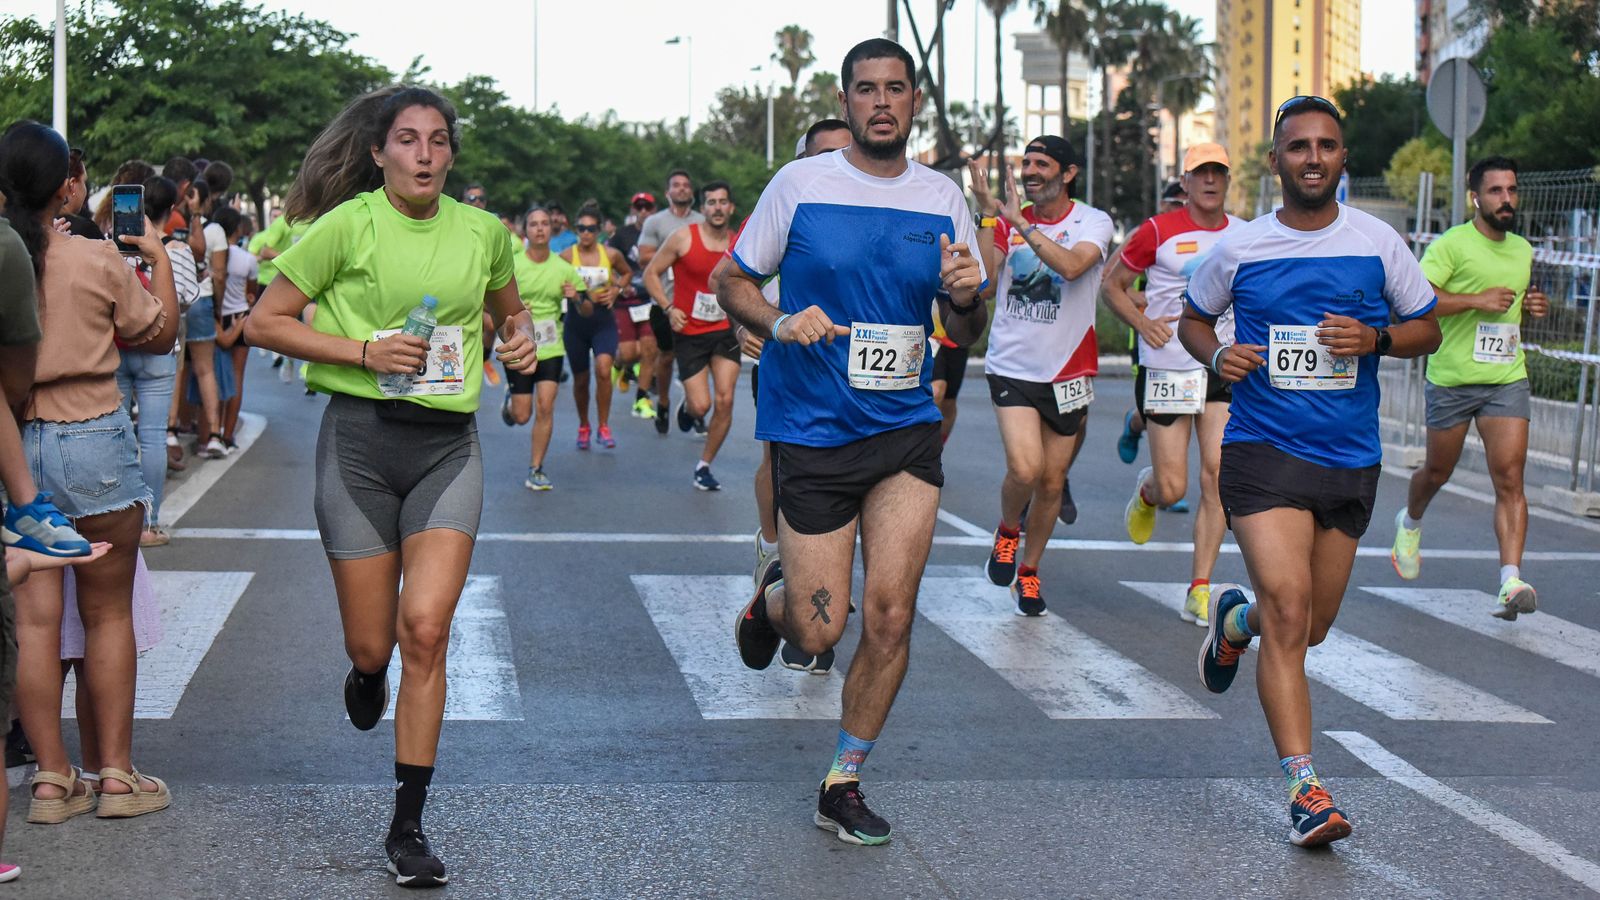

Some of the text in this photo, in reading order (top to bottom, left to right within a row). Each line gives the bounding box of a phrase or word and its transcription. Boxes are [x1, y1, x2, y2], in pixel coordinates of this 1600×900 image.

[903, 234, 928, 244] Algeciras
[1006, 295, 1057, 320] Vive la vida
[855, 328, 872, 339] XXI
[1274, 331, 1290, 341] XXI
[1480, 337, 1504, 352] 172
[857, 347, 897, 371] 122
[1277, 348, 1317, 372] 679
[1060, 380, 1082, 400] 752
[1152, 383, 1175, 397] 751
